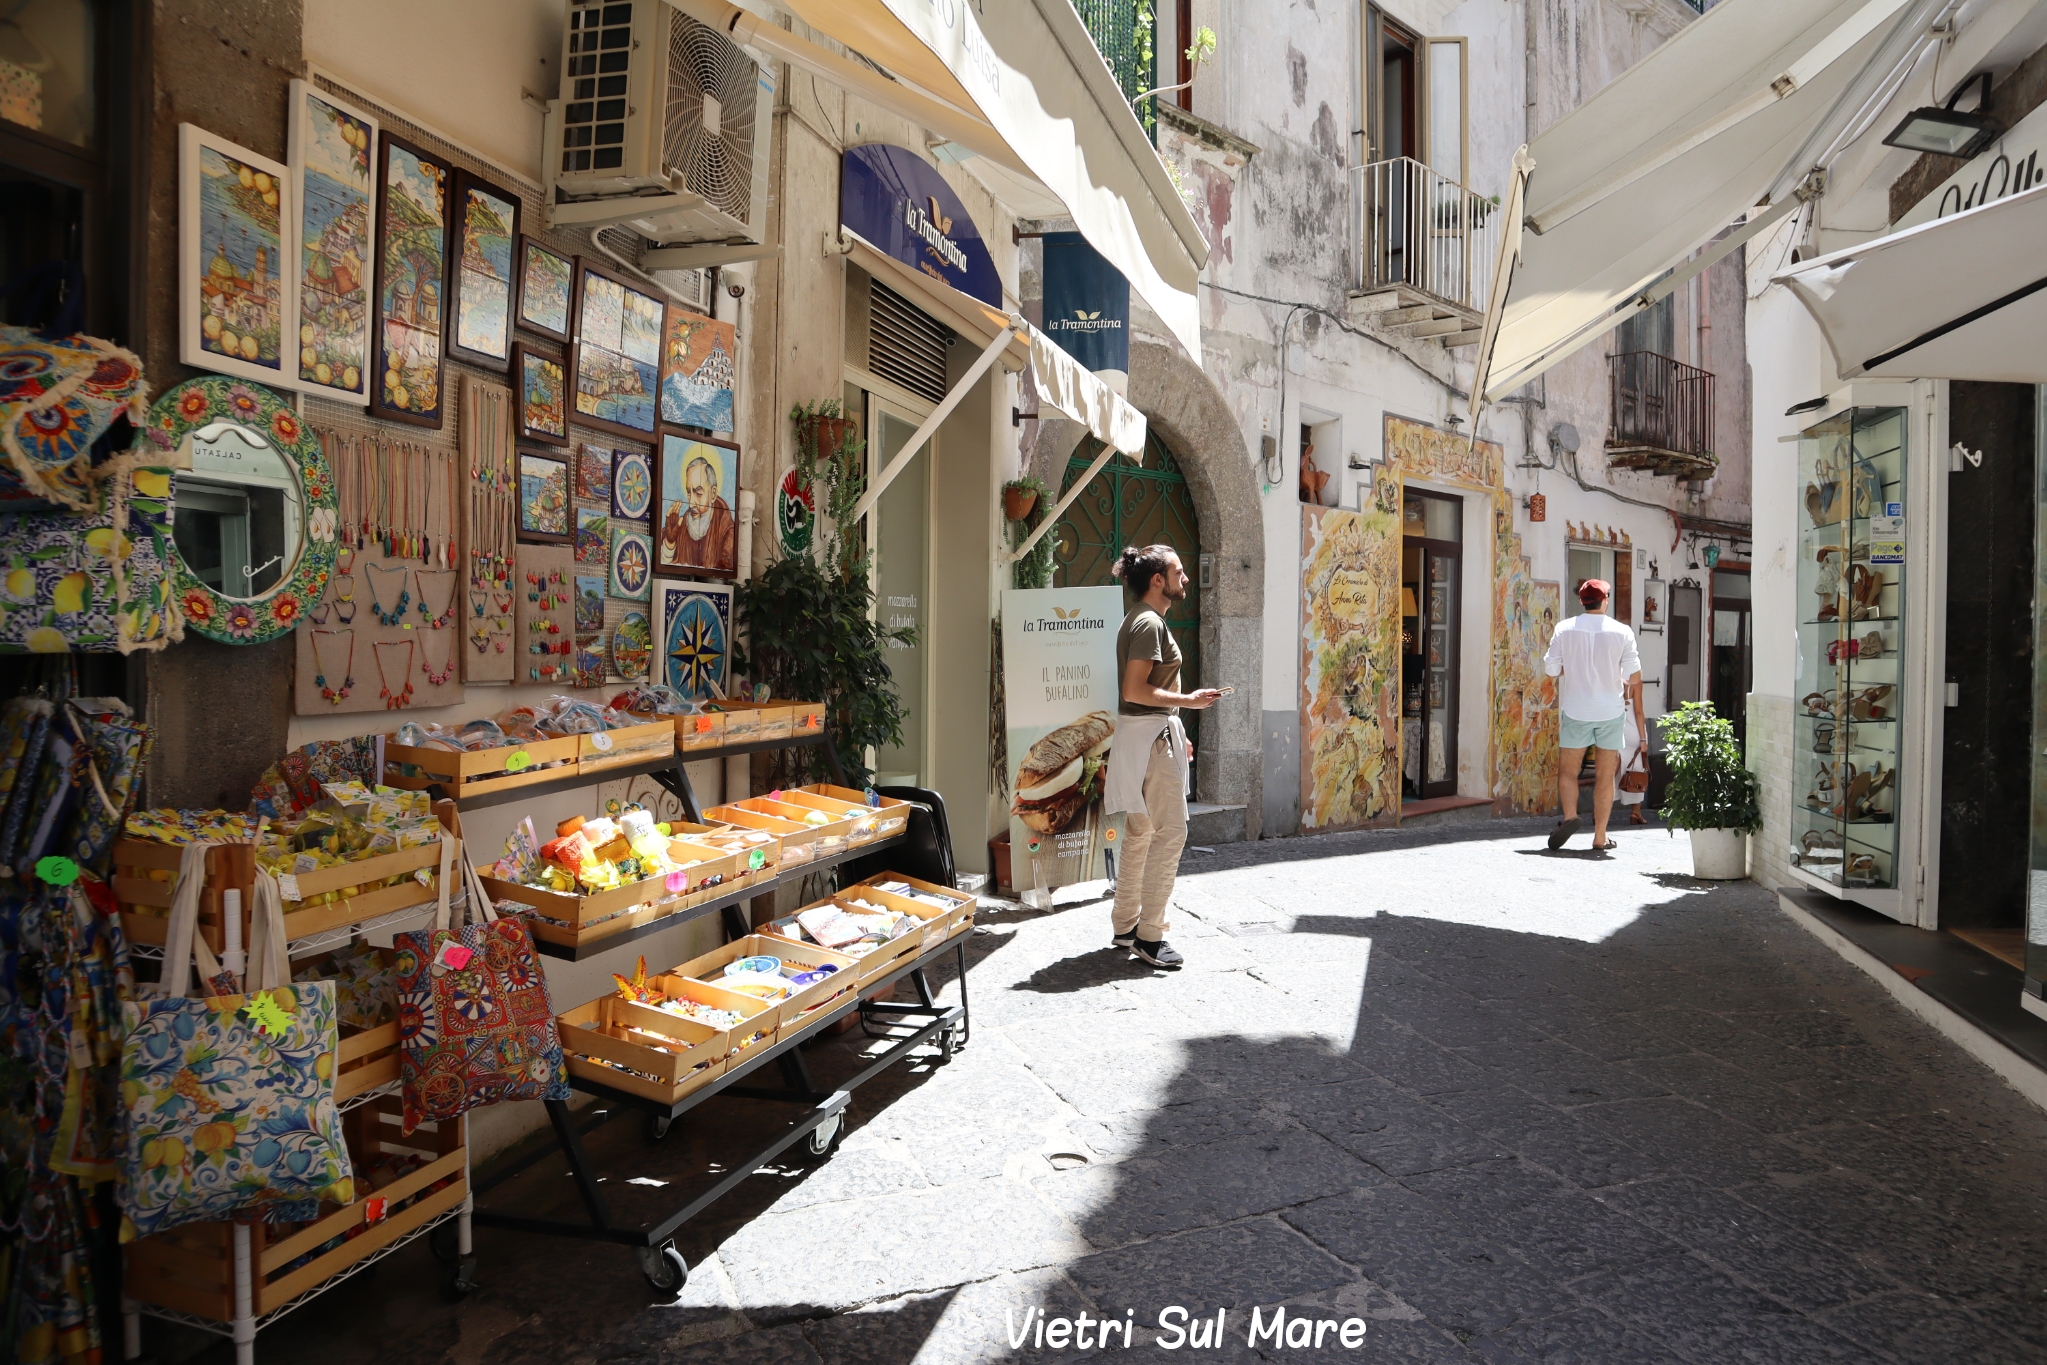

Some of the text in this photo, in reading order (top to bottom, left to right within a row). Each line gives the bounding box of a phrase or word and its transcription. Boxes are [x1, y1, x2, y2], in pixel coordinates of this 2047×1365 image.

[906, 198, 967, 273] la Tramontina
[1049, 318, 1122, 330] la Tramontina
[1871, 543, 1893, 554] Pago
[1332, 591, 1368, 605] Anna Rita
[890, 614, 896, 628] di
[1023, 617, 1104, 632] la Tramontina
[1042, 664, 1091, 683] IL PANINO
[1045, 684, 1089, 702] BUFALINO
[1055, 829, 1091, 840] mozzarella
[1057, 839, 1089, 849] di bufala
[51, 861, 63, 877] 6
